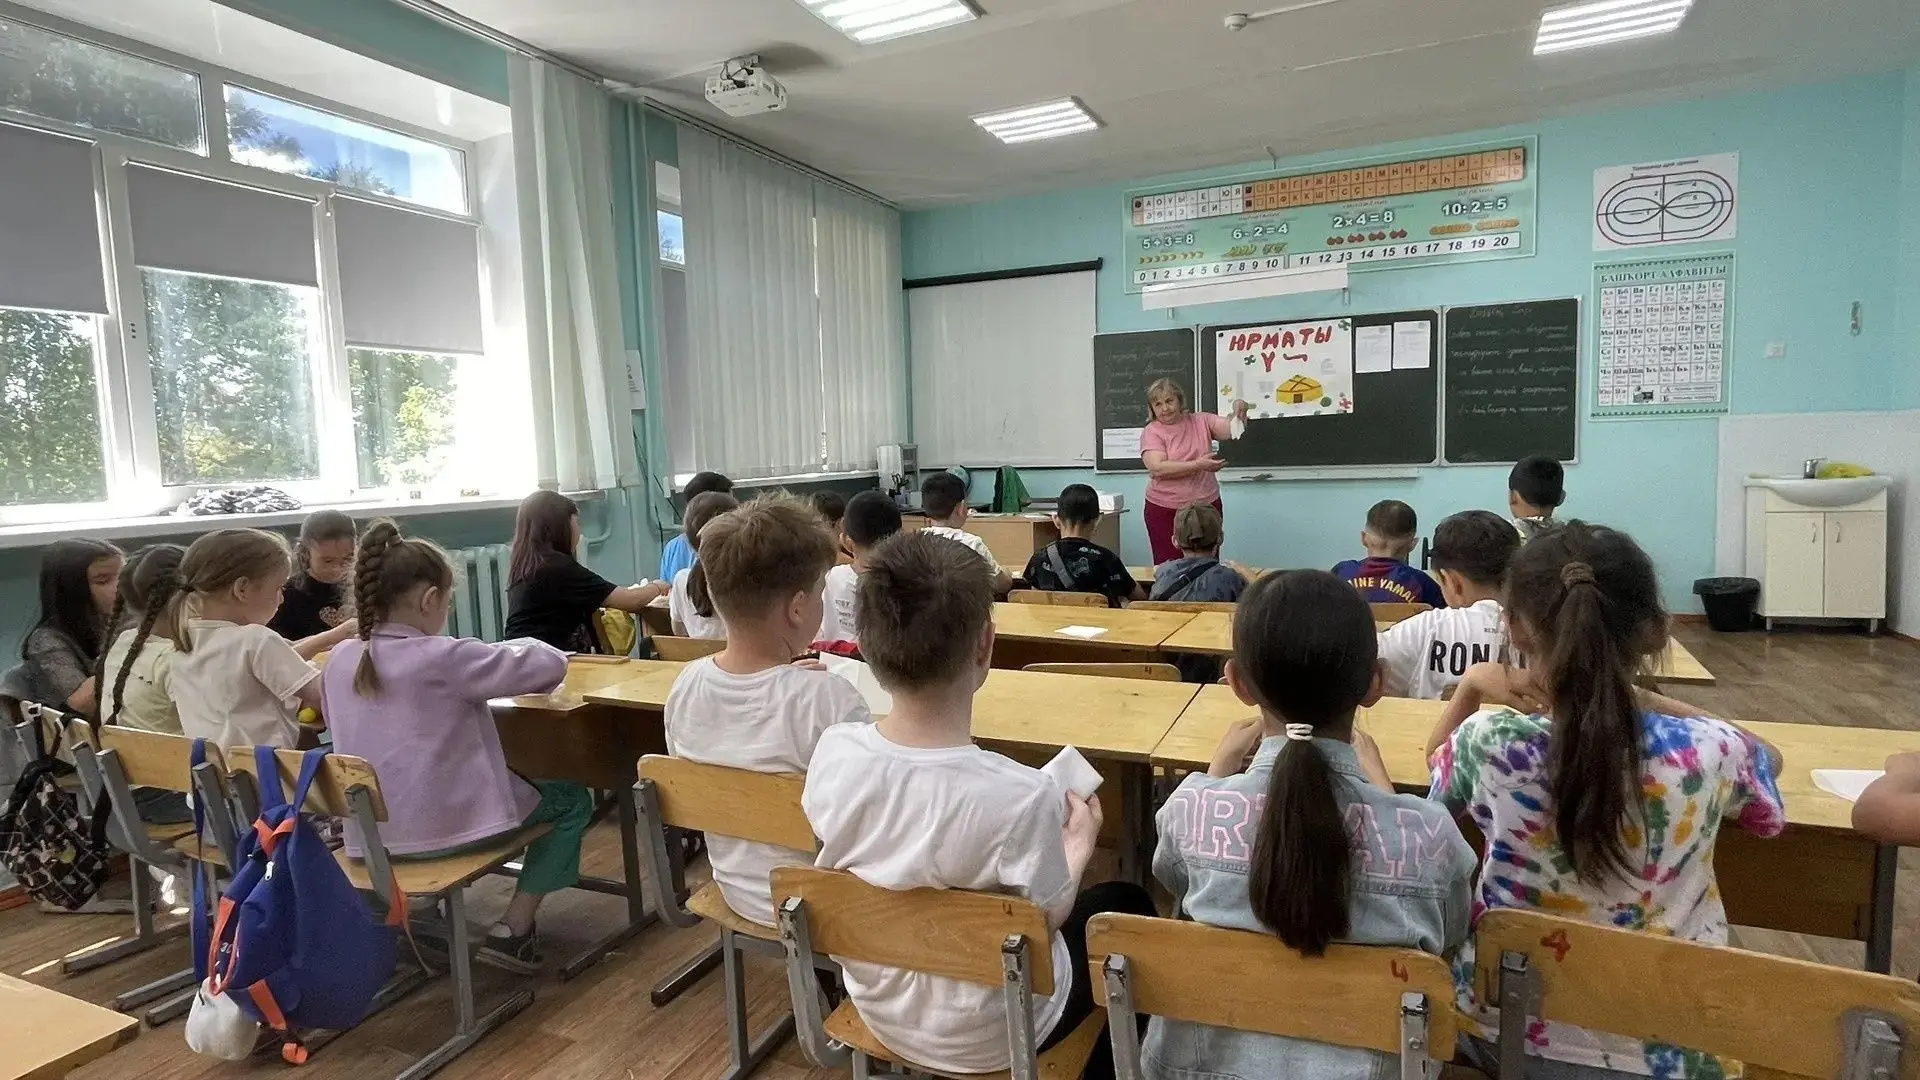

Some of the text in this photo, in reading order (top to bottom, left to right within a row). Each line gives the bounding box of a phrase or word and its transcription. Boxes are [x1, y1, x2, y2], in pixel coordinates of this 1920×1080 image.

[1140, 272, 1146, 281] 0
[1153, 271, 1157, 280] 1
[1164, 270, 1170, 279] 2
[1176, 269, 1182, 277] 3
[1188, 267, 1195, 276] 4
[1201, 266, 1207, 275] 5
[1213, 265, 1220, 274] 6
[1226, 263, 1233, 272] 7
[1239, 262, 1246, 271] 8
[1252, 260, 1259, 270] 9
[1266, 259, 1279, 268] 10
[1299, 256, 1310, 265] 11
[1319, 253, 1332, 263] 12
[1361, 249, 1374, 259] 14
[1382, 247, 1396, 257] 15
[1404, 245, 1418, 255] 16
[1426, 242, 1440, 253] 17
[1448, 241, 1463, 251] 18
[1470, 238, 1486, 249] 19
[1493, 236, 1509, 247] 20
[1168, 788, 1452, 879] DRAM
[1539, 927, 1571, 963] 4
